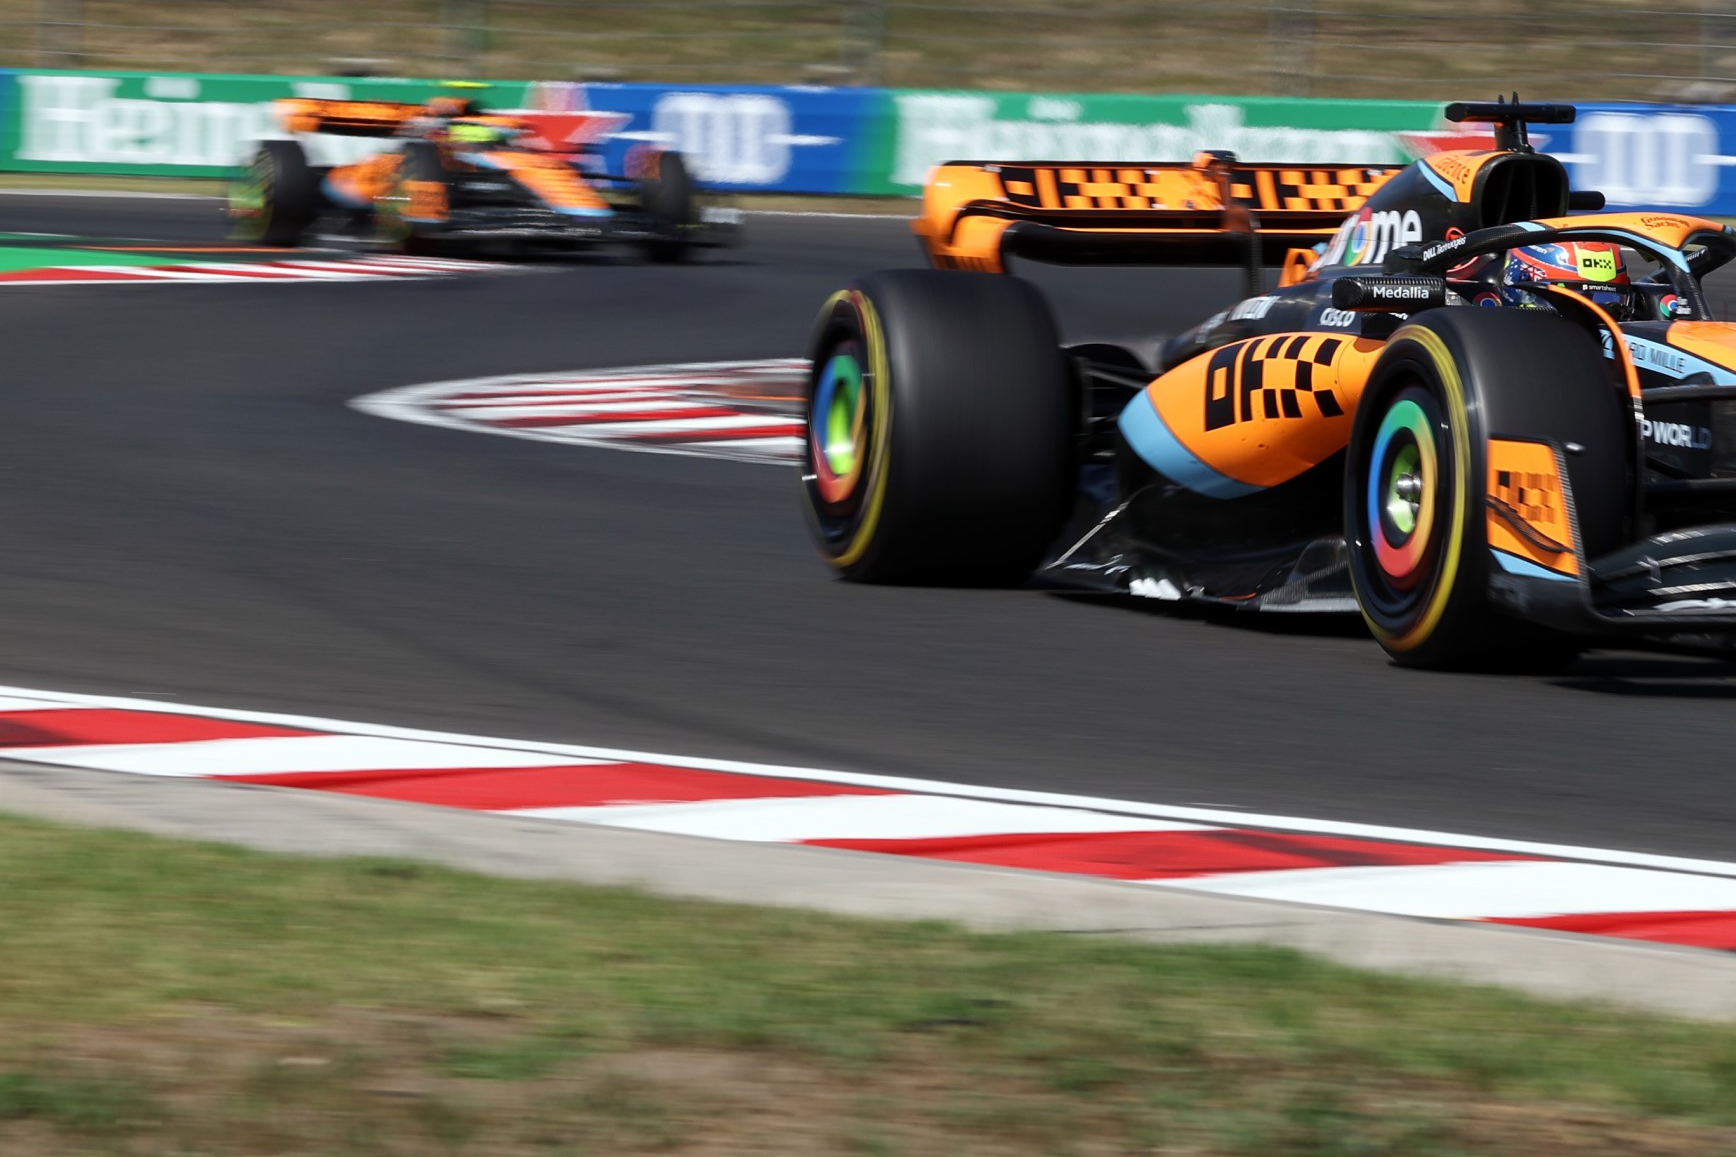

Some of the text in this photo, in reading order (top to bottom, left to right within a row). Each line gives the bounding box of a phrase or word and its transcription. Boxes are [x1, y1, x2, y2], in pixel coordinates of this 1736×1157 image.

[1583, 258, 1612, 270] OKX
[1373, 286, 1430, 299] Medallia
[1205, 336, 1344, 432] OKX
